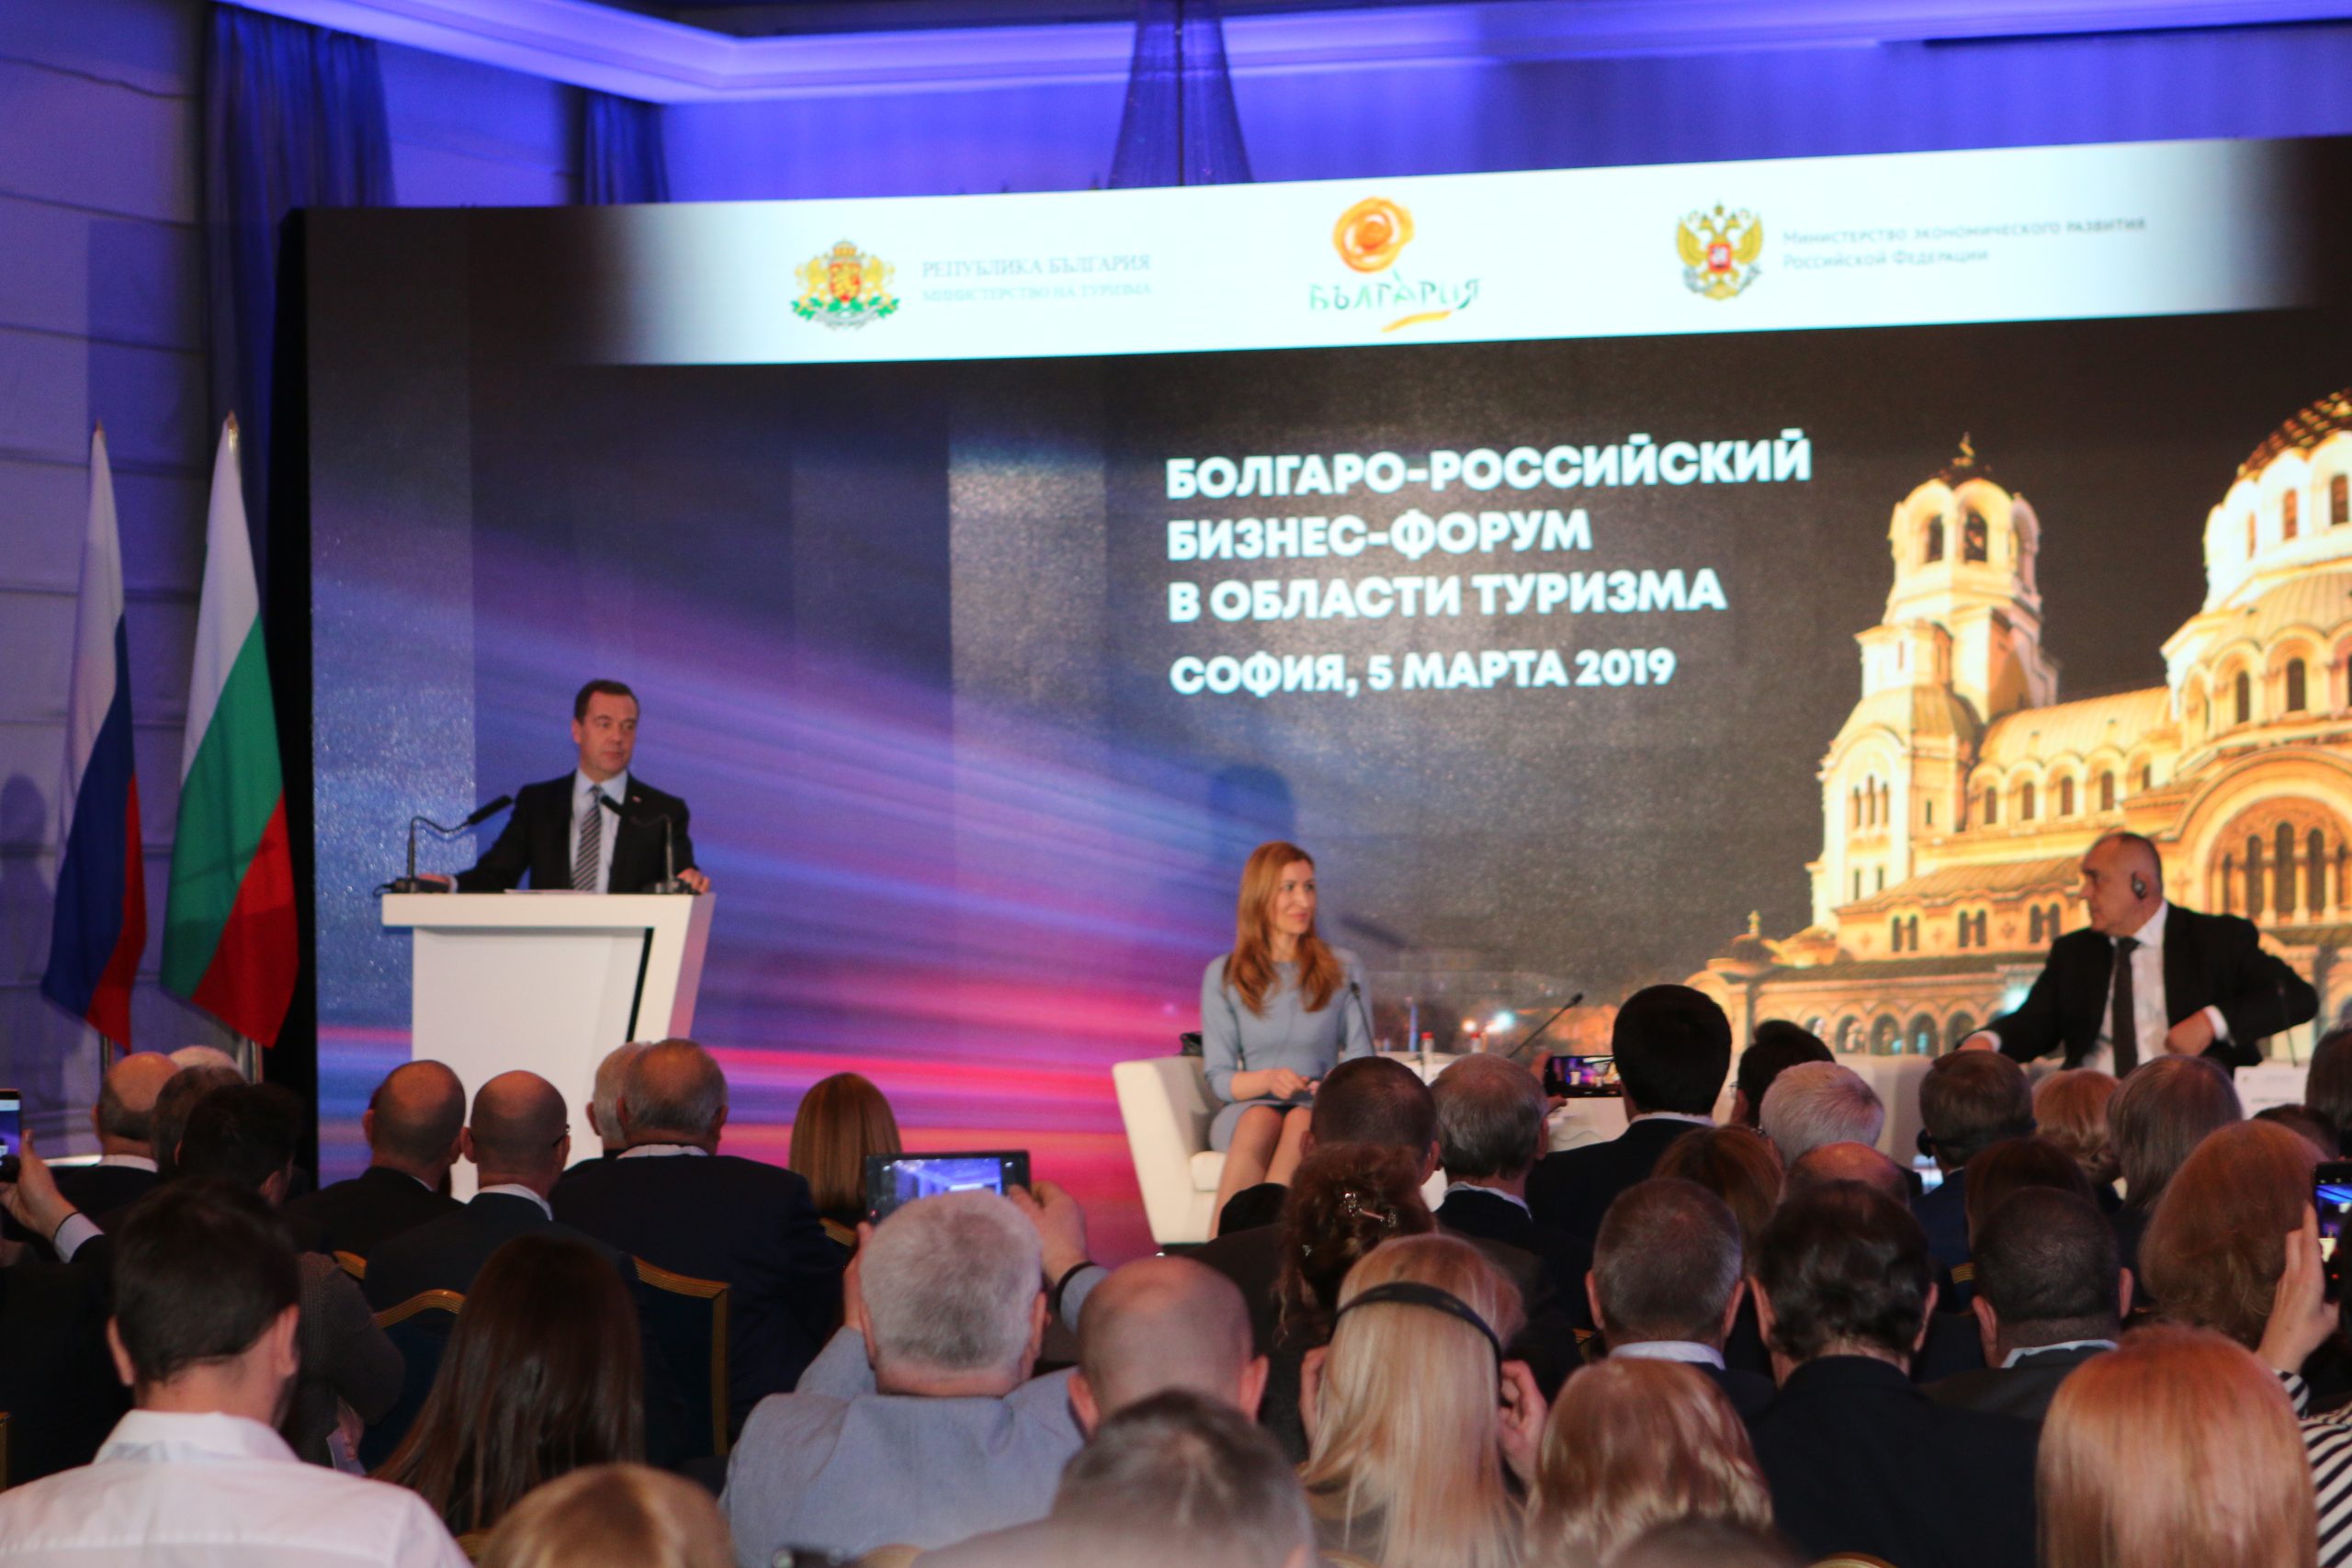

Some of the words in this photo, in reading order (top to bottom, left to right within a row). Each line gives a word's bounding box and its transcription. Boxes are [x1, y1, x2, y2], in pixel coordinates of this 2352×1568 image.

[922, 258, 1044, 278] РЕПУБЛИКА
[1049, 254, 1151, 275] БЪЛГАРИЯ
[1166, 428, 1812, 500] БОЛГАРО-РОССИЙСКИЙ
[1168, 508, 1593, 561] БИЗНЕС-ФОРУМ
[1169, 581, 1202, 623] В
[1209, 574, 1462, 622] ОБЛАСТИ
[1470, 567, 1729, 616] ТУРИЗМА
[1170, 649, 1361, 699] СОФИЯ,
[1366, 654, 1395, 692] 5
[1401, 649, 1569, 691] МАРТА
[1574, 647, 1677, 688] 2019
